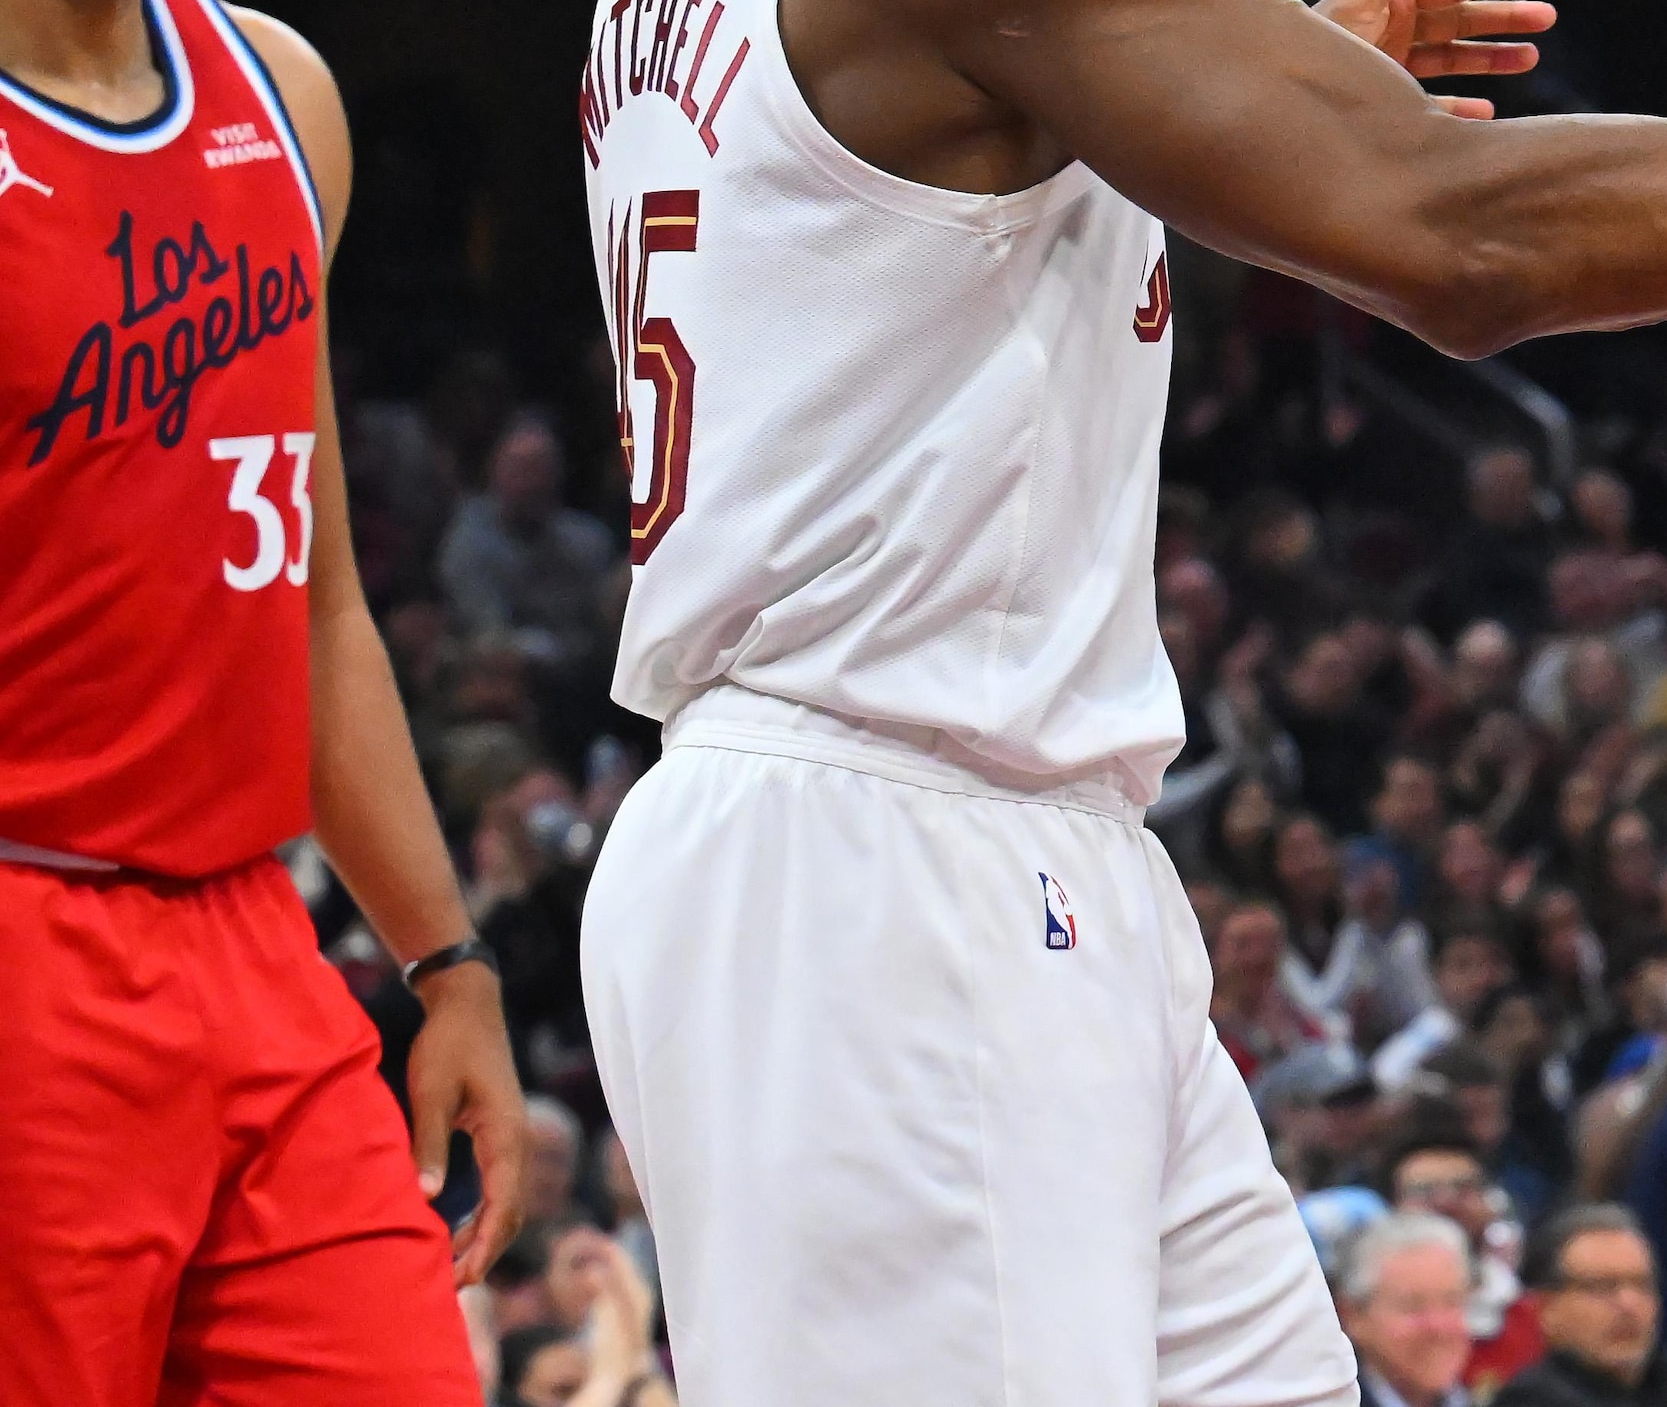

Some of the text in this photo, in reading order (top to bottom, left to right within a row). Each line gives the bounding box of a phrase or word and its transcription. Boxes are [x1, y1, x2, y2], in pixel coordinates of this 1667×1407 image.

[105, 209, 229, 329] Los
[26, 243, 314, 468] Angeles
[208, 432, 316, 592] 33
[1049, 931, 1067, 946] NBA
